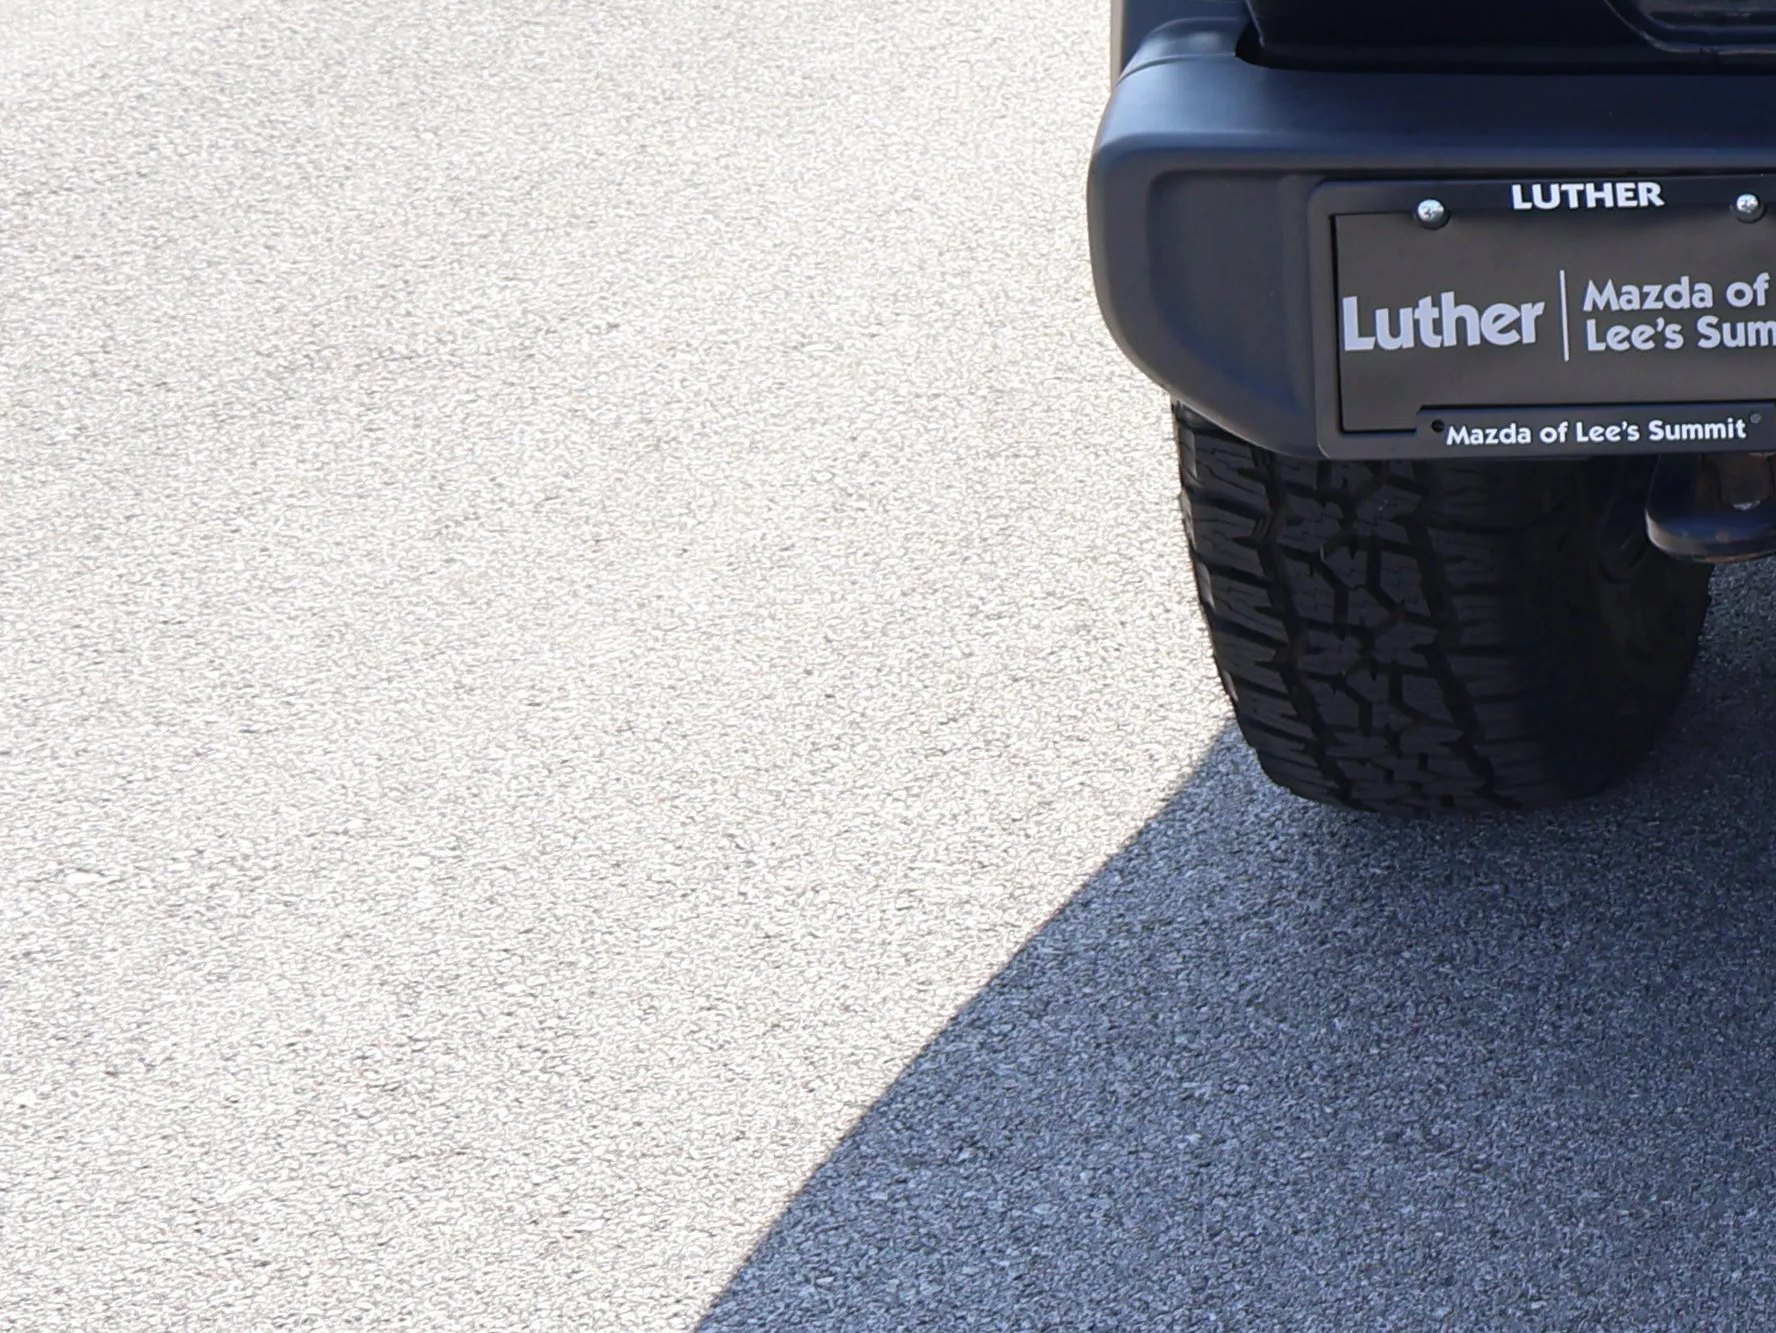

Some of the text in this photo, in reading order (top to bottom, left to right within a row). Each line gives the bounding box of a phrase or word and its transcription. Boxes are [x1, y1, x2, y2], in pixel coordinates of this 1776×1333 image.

[1511, 182, 1665, 209] LUTHER
[1583, 272, 1770, 312] Mazda of
[1342, 291, 1545, 351] Luther
[1586, 317, 1684, 352] Lee's
[1446, 419, 1747, 446] Mazda of Lee's Summit
